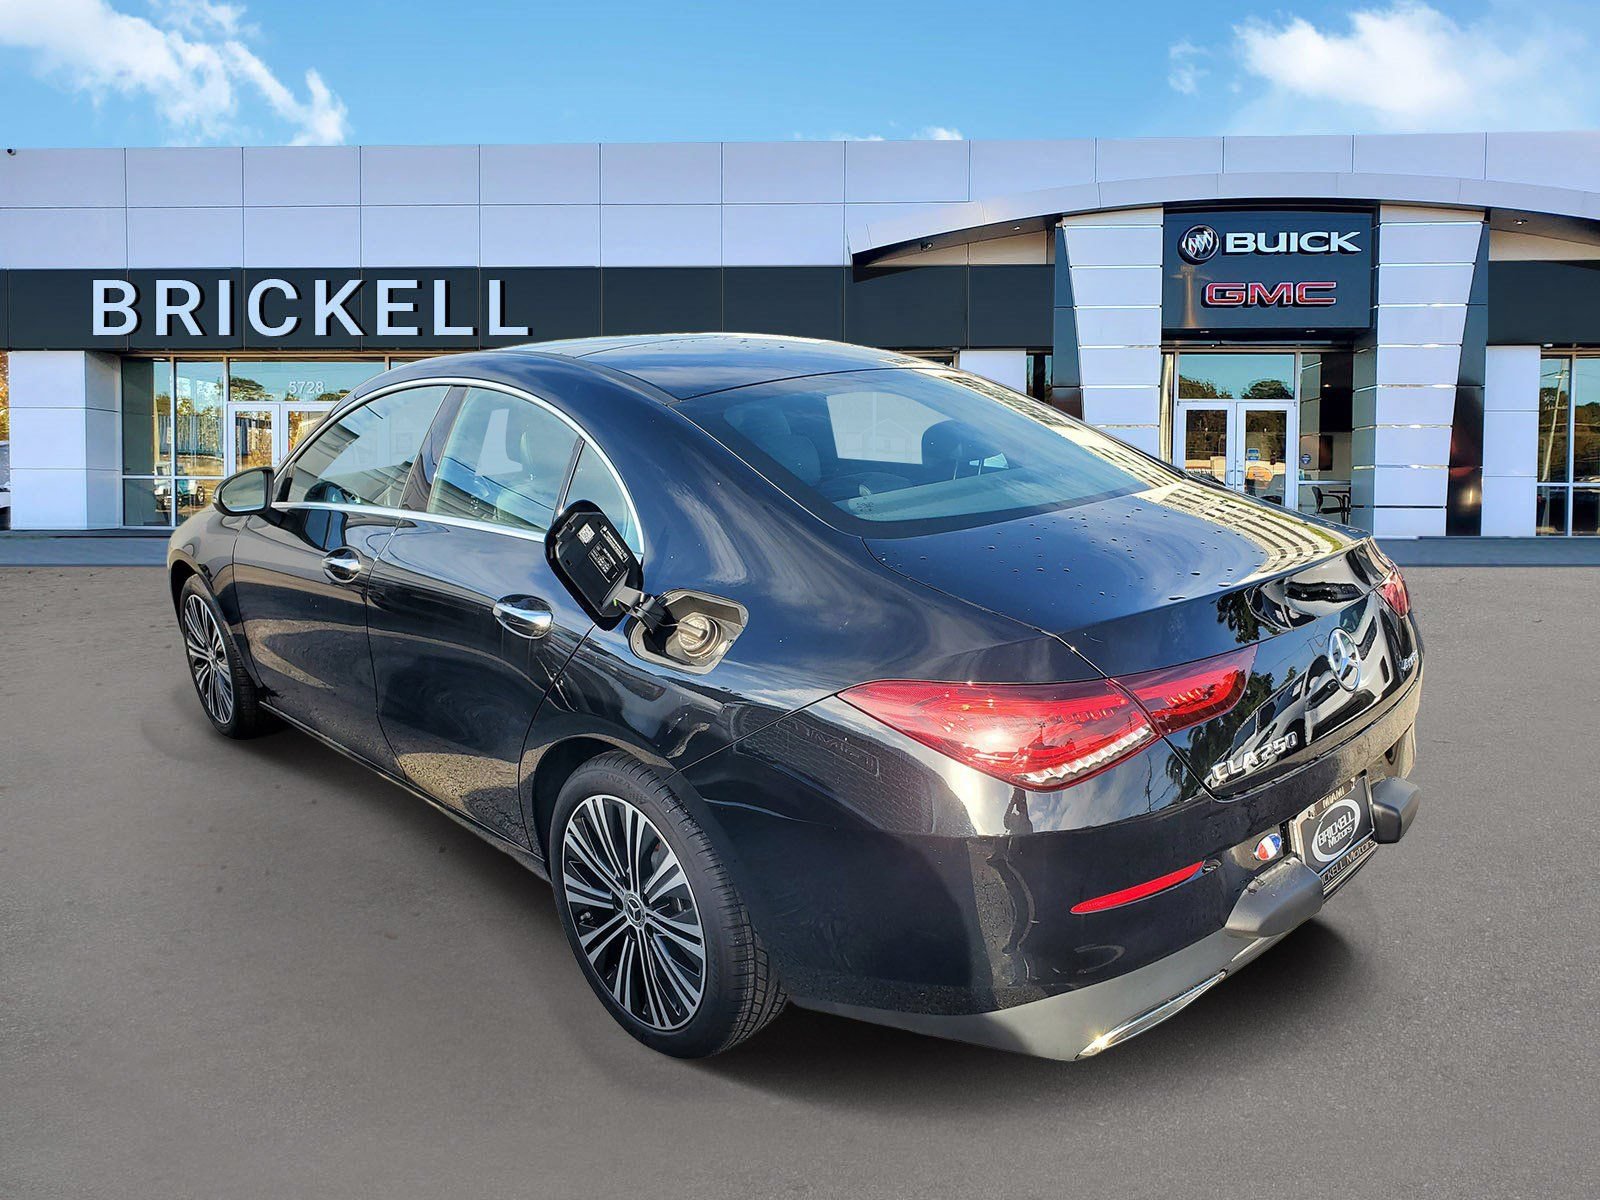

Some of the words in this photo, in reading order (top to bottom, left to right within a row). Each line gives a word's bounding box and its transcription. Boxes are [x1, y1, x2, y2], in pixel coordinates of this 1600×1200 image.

[1225, 231, 1362, 253] BUICK
[1205, 281, 1337, 305] GMC
[92, 278, 531, 337] BRICKELL
[289, 380, 325, 394] 5728
[1322, 786, 1345, 808] MIAMI
[1318, 811, 1355, 847] BRICKELL
[1320, 860, 1346, 886] ICKELL
